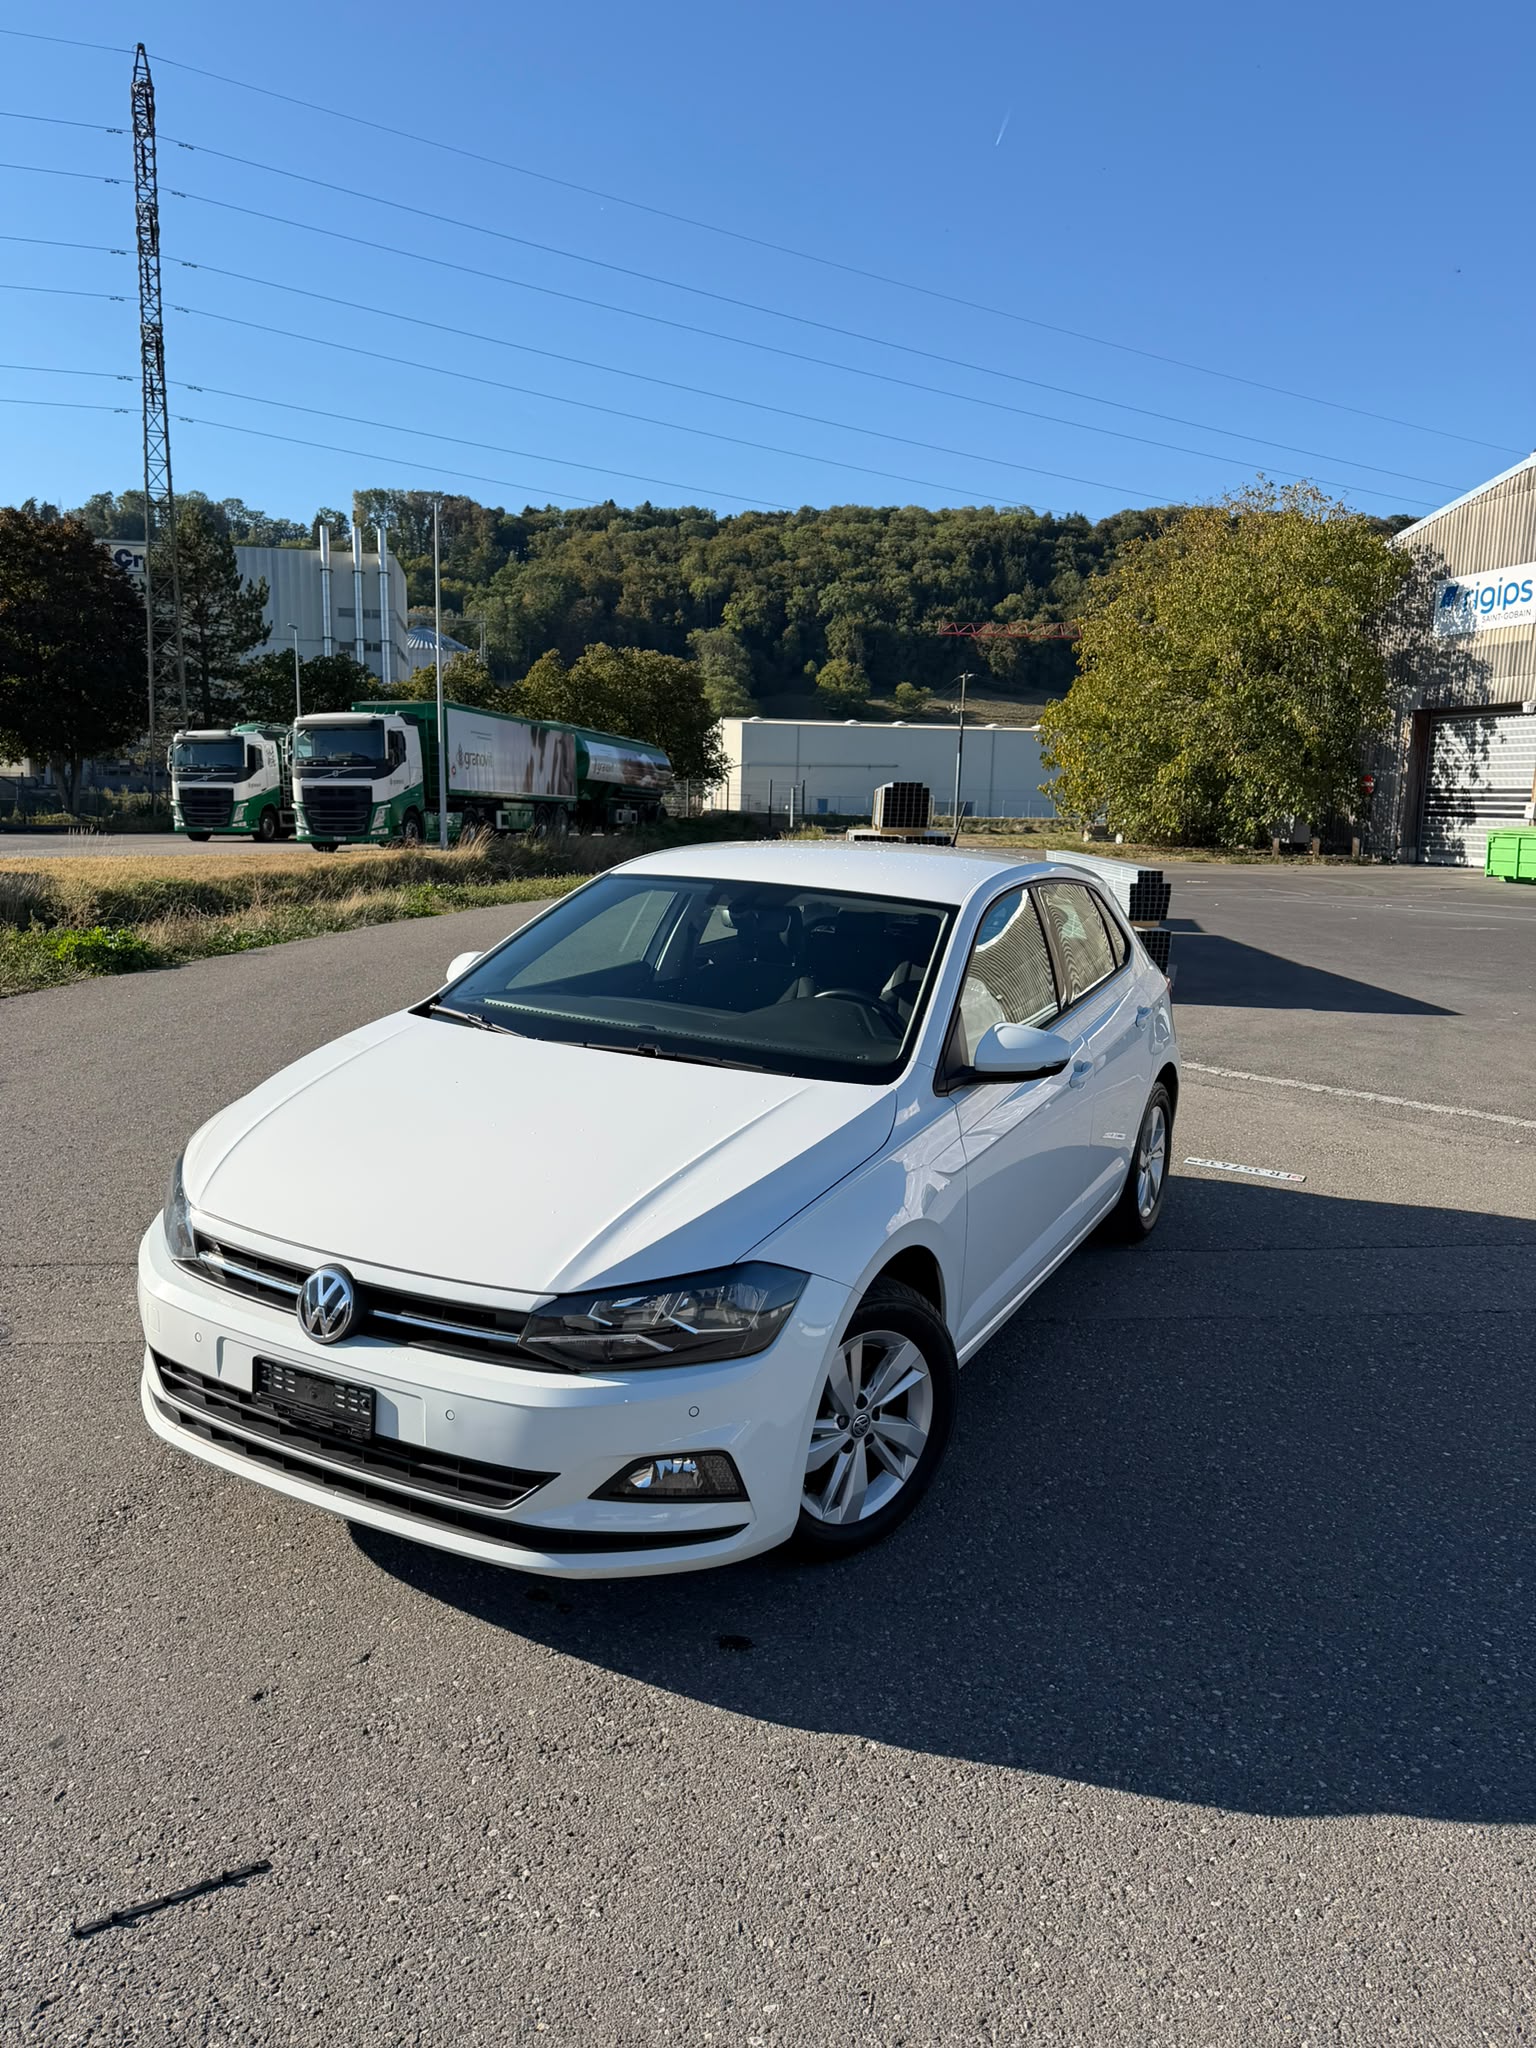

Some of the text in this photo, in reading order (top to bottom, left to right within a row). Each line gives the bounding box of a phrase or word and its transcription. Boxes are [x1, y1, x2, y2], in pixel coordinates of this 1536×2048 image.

[114, 549, 143, 568] Cr
[1462, 577, 1534, 614] rigips
[1481, 609, 1532, 623] SAINT-GOBAIN
